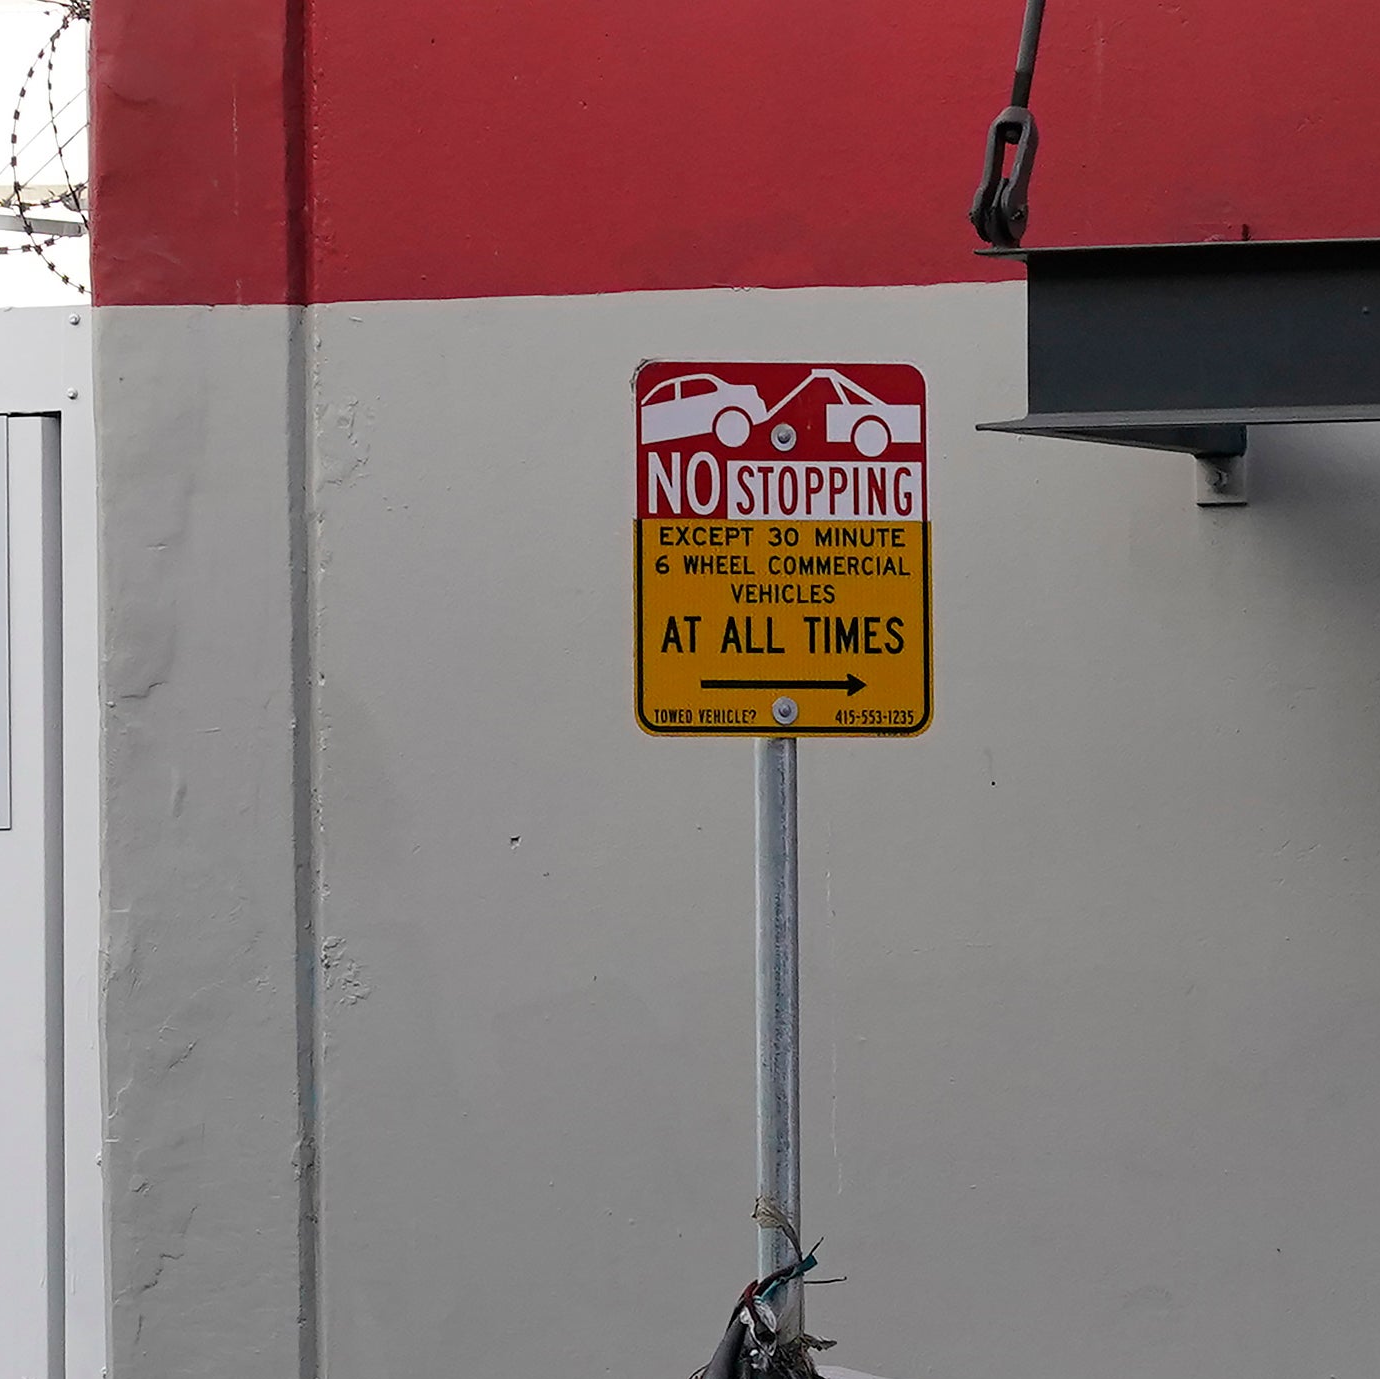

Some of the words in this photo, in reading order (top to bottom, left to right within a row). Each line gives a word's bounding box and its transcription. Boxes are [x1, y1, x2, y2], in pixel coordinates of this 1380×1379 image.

[649, 452, 720, 515] NO
[737, 466, 912, 516] STOPPING
[660, 527, 754, 546] EXCEPT
[768, 527, 799, 547] 30
[815, 527, 905, 547] MINUTE
[655, 555, 669, 574] 6
[684, 555, 755, 575] WHEEL
[769, 556, 910, 576] COMMERCIAL
[731, 584, 835, 604] VEHICLES
[661, 616, 701, 653] AT
[721, 616, 785, 654] ALL
[804, 617, 904, 654] TIMES
[655, 709, 692, 723] TOWED
[699, 709, 756, 724] VEHICLE?
[835, 710, 913, 725] 415-553-1235
